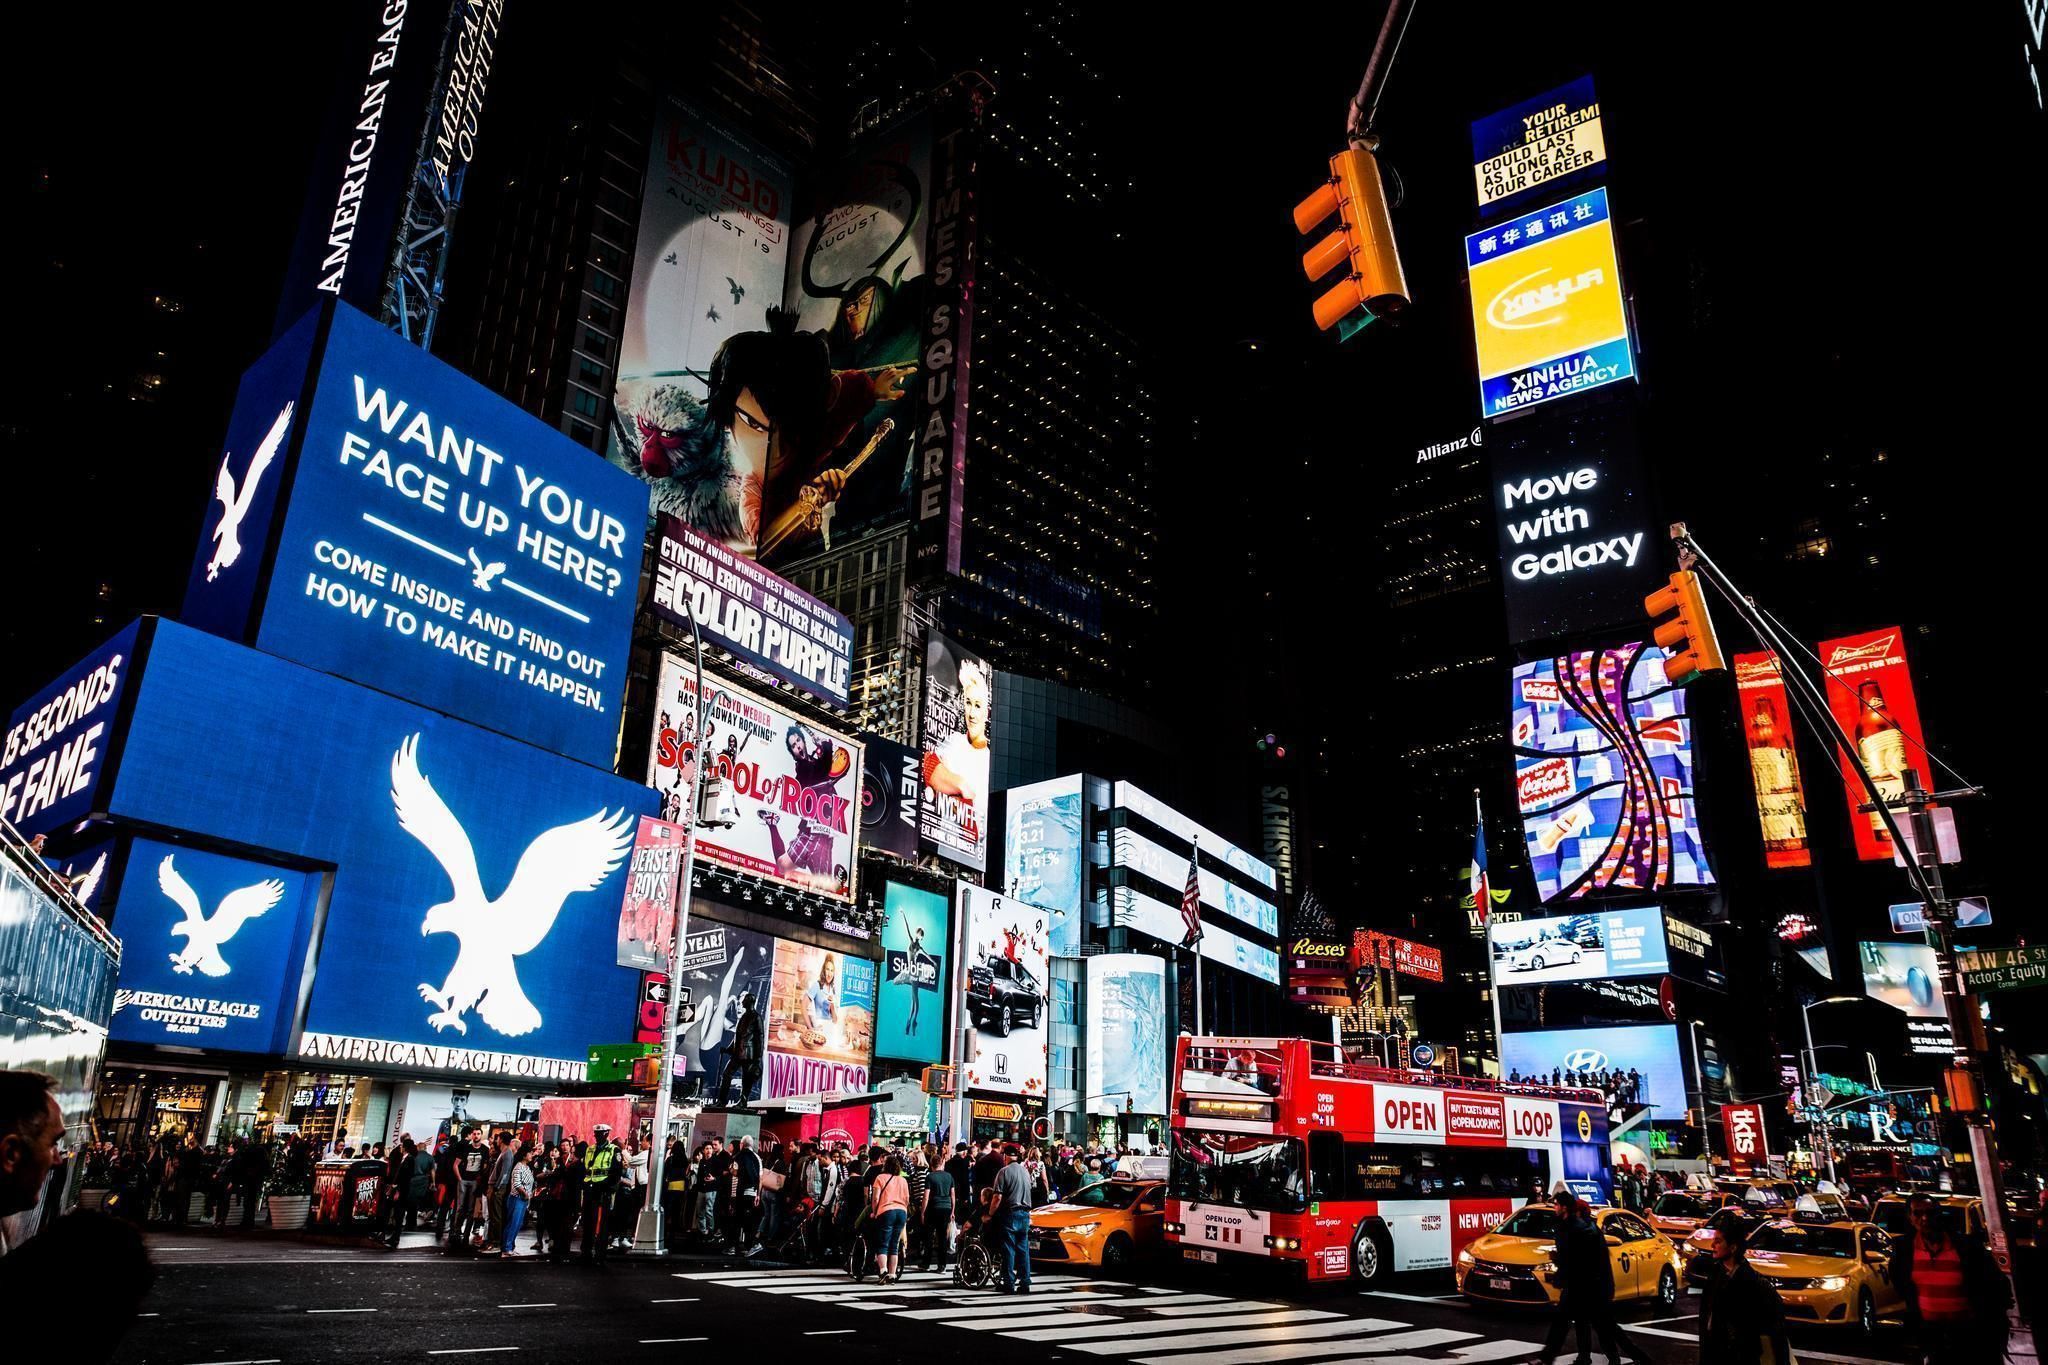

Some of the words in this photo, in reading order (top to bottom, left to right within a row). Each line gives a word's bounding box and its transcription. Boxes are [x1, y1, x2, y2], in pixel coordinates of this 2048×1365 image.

[1522, 103, 1568, 130] YOUR
[1482, 146, 1531, 175] COULD
[1536, 129, 1576, 154] LAST
[1484, 172, 1503, 188] AS
[1509, 154, 1549, 178] LONG
[1555, 143, 1575, 161] AS
[667, 121, 779, 221] KUBO
[1485, 176, 1526, 200] YOUR
[1532, 150, 1594, 182] CAREER
[317, 80, 389, 295] AMERICAN
[666, 186, 745, 238] AUGUST
[753, 238, 770, 254] 19
[719, 195, 774, 234] STRINGS
[935, 128, 963, 287] TIMES
[814, 211, 879, 254] AUGUST
[1478, 202, 1594, 255] 新华通讯社
[1511, 354, 1598, 392] XINHUA
[1494, 387, 1544, 411] NEWS
[1546, 364, 1619, 396] AGENCY
[920, 304, 952, 521] SQUARE
[1416, 436, 1468, 464] Allianz
[353, 374, 503, 487] WANT
[515, 465, 626, 558] YOUR
[1503, 468, 1598, 509] Move
[339, 431, 450, 514] FACE
[458, 492, 510, 537] UP
[517, 522, 622, 597] HERE?
[1507, 505, 1589, 544] with
[917, 543, 939, 560] NYC
[1511, 532, 1643, 580] Galaxy
[684, 529, 706, 552] TONY
[706, 539, 733, 567] AWARD
[735, 558, 765, 585] WINNER!
[765, 576, 783, 594] BEST
[783, 585, 812, 613] MUSICAL
[813, 604, 838, 628] REVIVAL
[314, 540, 387, 586] COME
[391, 571, 465, 620] INSIDE
[468, 608, 514, 640] AND
[518, 629, 564, 662] FIND
[566, 650, 606, 679] OUT
[660, 536, 714, 582] CYNTHIA
[716, 566, 753, 602] ERIVO
[763, 592, 809, 629] HEATHER
[810, 619, 852, 656] HEADLEY
[305, 572, 378, 619] HOW
[383, 603, 417, 635] TO
[422, 620, 491, 667] MAKE
[493, 650, 516, 674] IT
[518, 660, 606, 712] HAPPEN.
[654, 564, 677, 611] THE
[672, 570, 763, 654] COLOR
[763, 616, 851, 702] PURPLE
[1834, 644, 1889, 662] Budweiser
[1869, 660, 1885, 669] FOR
[20, 653, 122, 753] SECONDS
[677, 690, 694, 710] HAS
[928, 697, 956, 729] TICKETS
[743, 702, 772, 727] WEBBER
[927, 717, 938, 737] ON
[15, 722, 105, 824] FAME
[657, 727, 765, 802] SCOOL
[761, 776, 782, 804] of
[780, 775, 850, 835] ROCK
[900, 755, 919, 828] NEW
[1021, 827, 1044, 844] 3.21
[1262, 784, 1293, 895] ERSHEY'S
[631, 847, 680, 873] JERSEY
[631, 872, 669, 900] BOYS
[1467, 910, 1522, 926] WCKED
[687, 932, 723, 953] YEARS
[1292, 937, 1347, 957] Reese's
[892, 957, 936, 980] StubHub
[1414, 954, 1439, 970] PLAZA
[1980, 952, 1996, 969] W
[2006, 950, 2028, 966] 46
[2035, 948, 2047, 960] St
[1968, 969, 2005, 985] Actors'
[2010, 964, 2047, 981] Equity
[1997, 979, 2018, 989] Corner
[128, 991, 207, 1015] MERICAN
[207, 999, 261, 1019] EAGLE
[140, 1008, 227, 1028] OUTFITTERS
[304, 1035, 438, 1068] AMERICAN
[446, 1049, 512, 1074] EAGLE
[517, 1055, 588, 1082] OUTFIT
[989, 1075, 1012, 1085] HONDA
[976, 1103, 987, 1117] DOS
[1317, 1093, 1334, 1103] OPEN
[1317, 1103, 1334, 1113] LOOP
[1450, 1104, 1461, 1113] BUY
[1462, 1105, 1483, 1115] TICKETS
[1483, 1107, 1500, 1116] ONLINE
[1297, 1117, 1307, 1125] 120
[1384, 1100, 1437, 1131] OPEN
[1451, 1117, 1501, 1130] @OPENLOOP.NYC
[1513, 1109, 1553, 1137] LOOP
[1867, 1111, 1908, 1143] R
[1731, 1108, 1757, 1154] tkts
[357, 1179, 379, 1192] JERSEY
[1205, 1214, 1223, 1222] OPEN
[1223, 1217, 1242, 1225] LOOP
[1428, 1223, 1441, 1231] ENJOY
[1459, 1213, 1481, 1230] NEW
[1482, 1212, 1505, 1229] YORK
[1326, 1255, 1346, 1264] ONLINE
